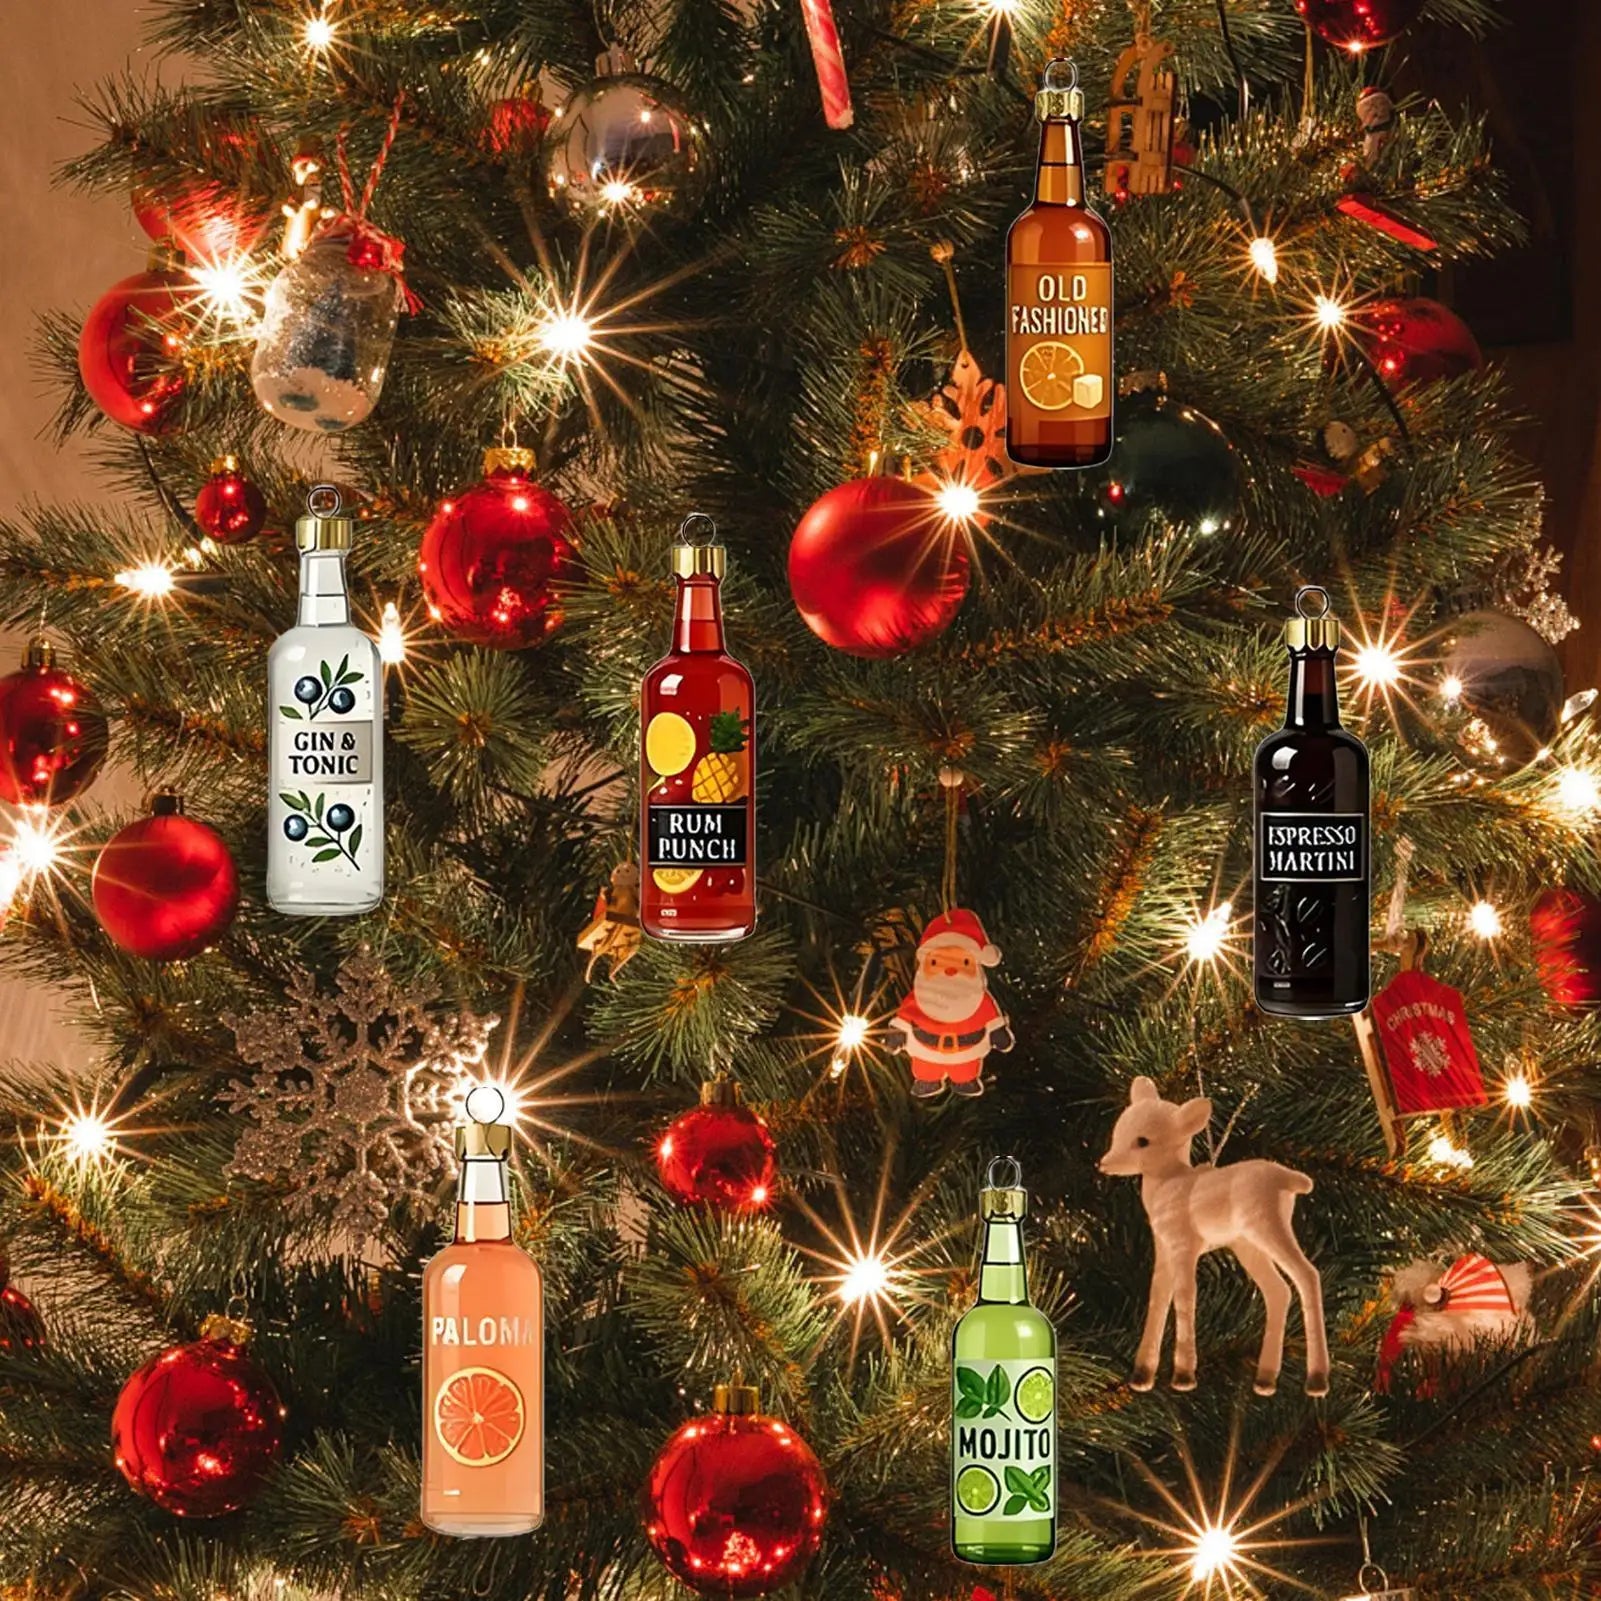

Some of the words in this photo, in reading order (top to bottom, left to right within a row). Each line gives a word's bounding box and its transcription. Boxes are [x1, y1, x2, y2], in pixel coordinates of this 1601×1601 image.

[1038, 274, 1087, 302] OLD
[294, 731, 335, 752] GIN
[340, 731, 356, 752] &
[288, 754, 360, 775] TONIC
[669, 812, 722, 835] RUM
[1268, 825, 1356, 846] ESPRESSO
[658, 836, 736, 860] PUNCH
[959, 1426, 1050, 1461] MOJITO
